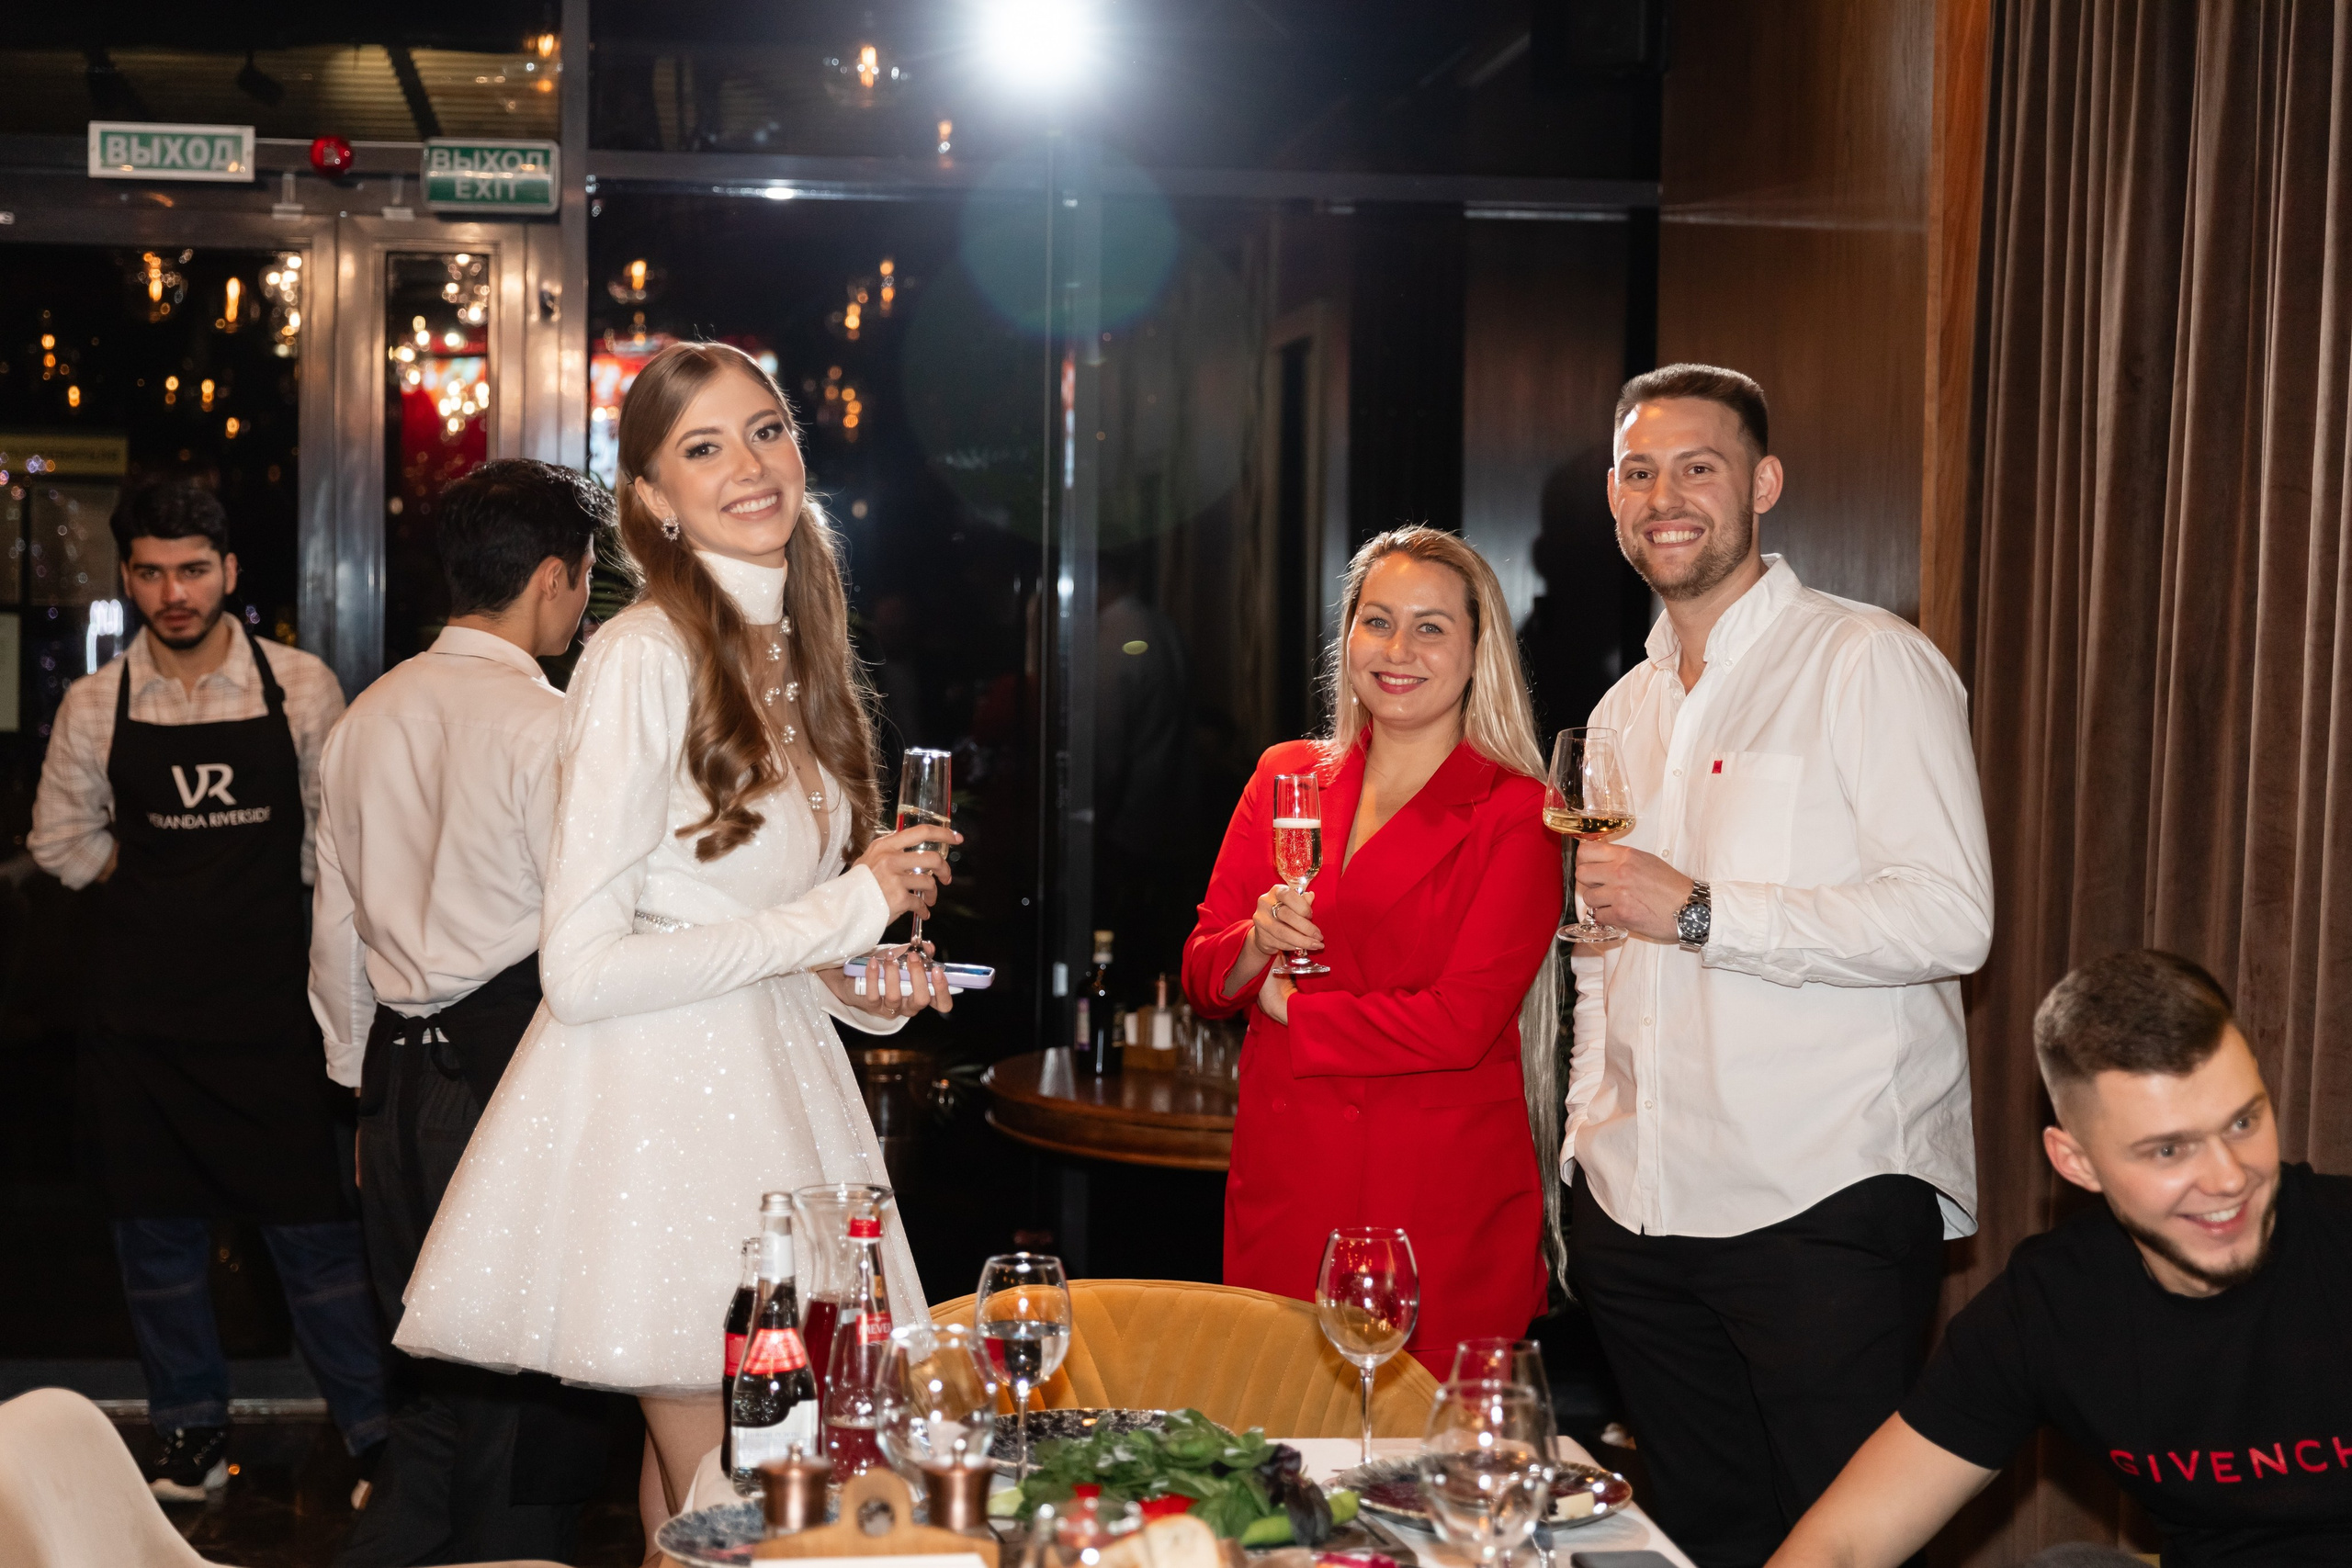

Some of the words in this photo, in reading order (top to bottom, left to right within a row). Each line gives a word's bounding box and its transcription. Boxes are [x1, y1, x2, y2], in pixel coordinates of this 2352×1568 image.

[107, 135, 235, 170] ВЫХОД
[430, 149, 546, 174] ВЫХОД
[455, 177, 519, 200] EXIT
[171, 763, 237, 808] VR
